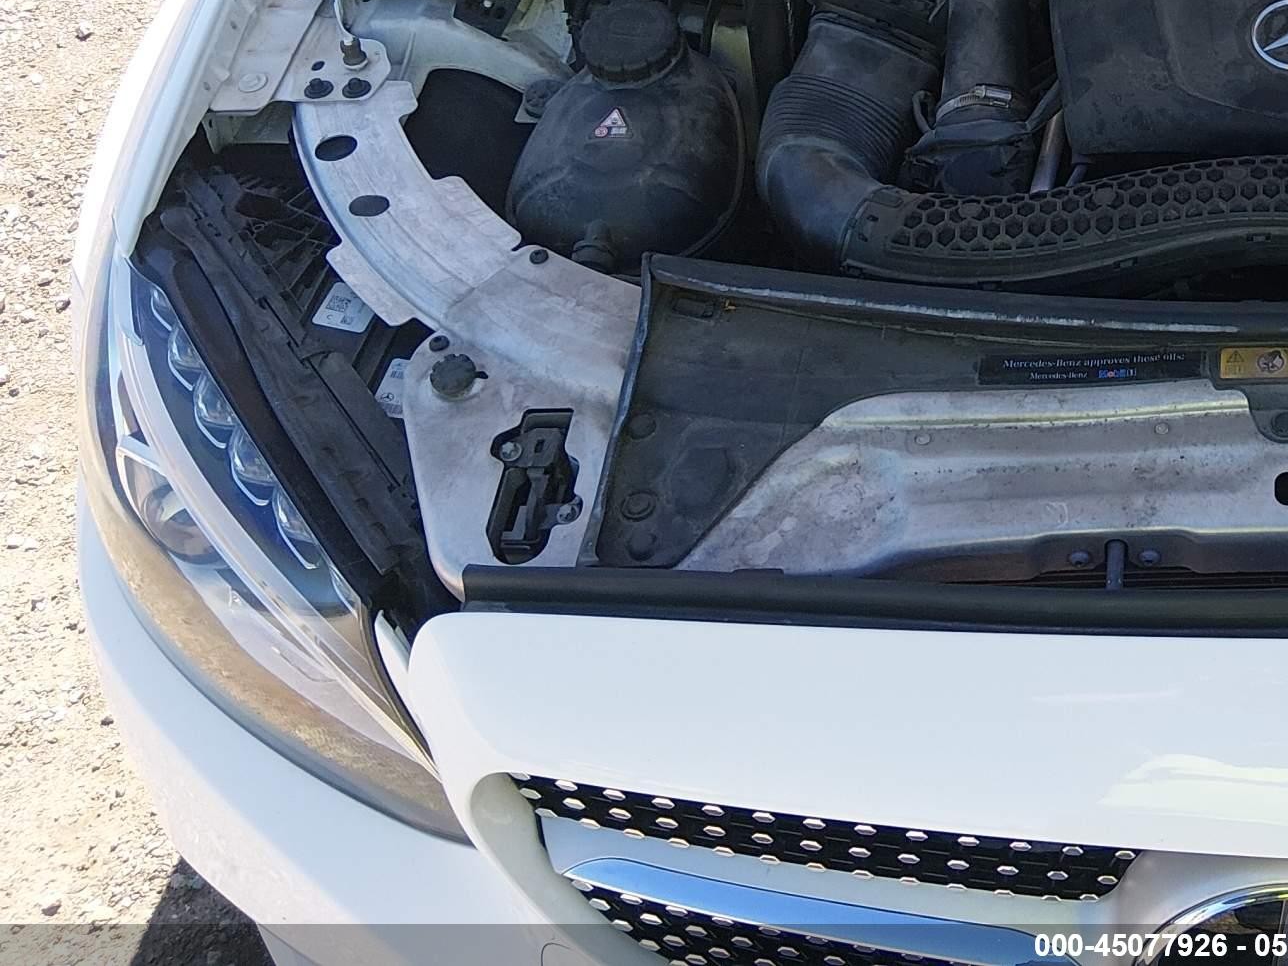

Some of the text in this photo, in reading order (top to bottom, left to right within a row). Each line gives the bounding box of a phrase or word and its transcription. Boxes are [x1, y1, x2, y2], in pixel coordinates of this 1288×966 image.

[1003, 359, 1081, 369] Mercedes-Benz
[1083, 356, 1130, 367] approves
[1133, 354, 1161, 363] these
[1030, 372, 1088, 380] Mercedes-Benz
